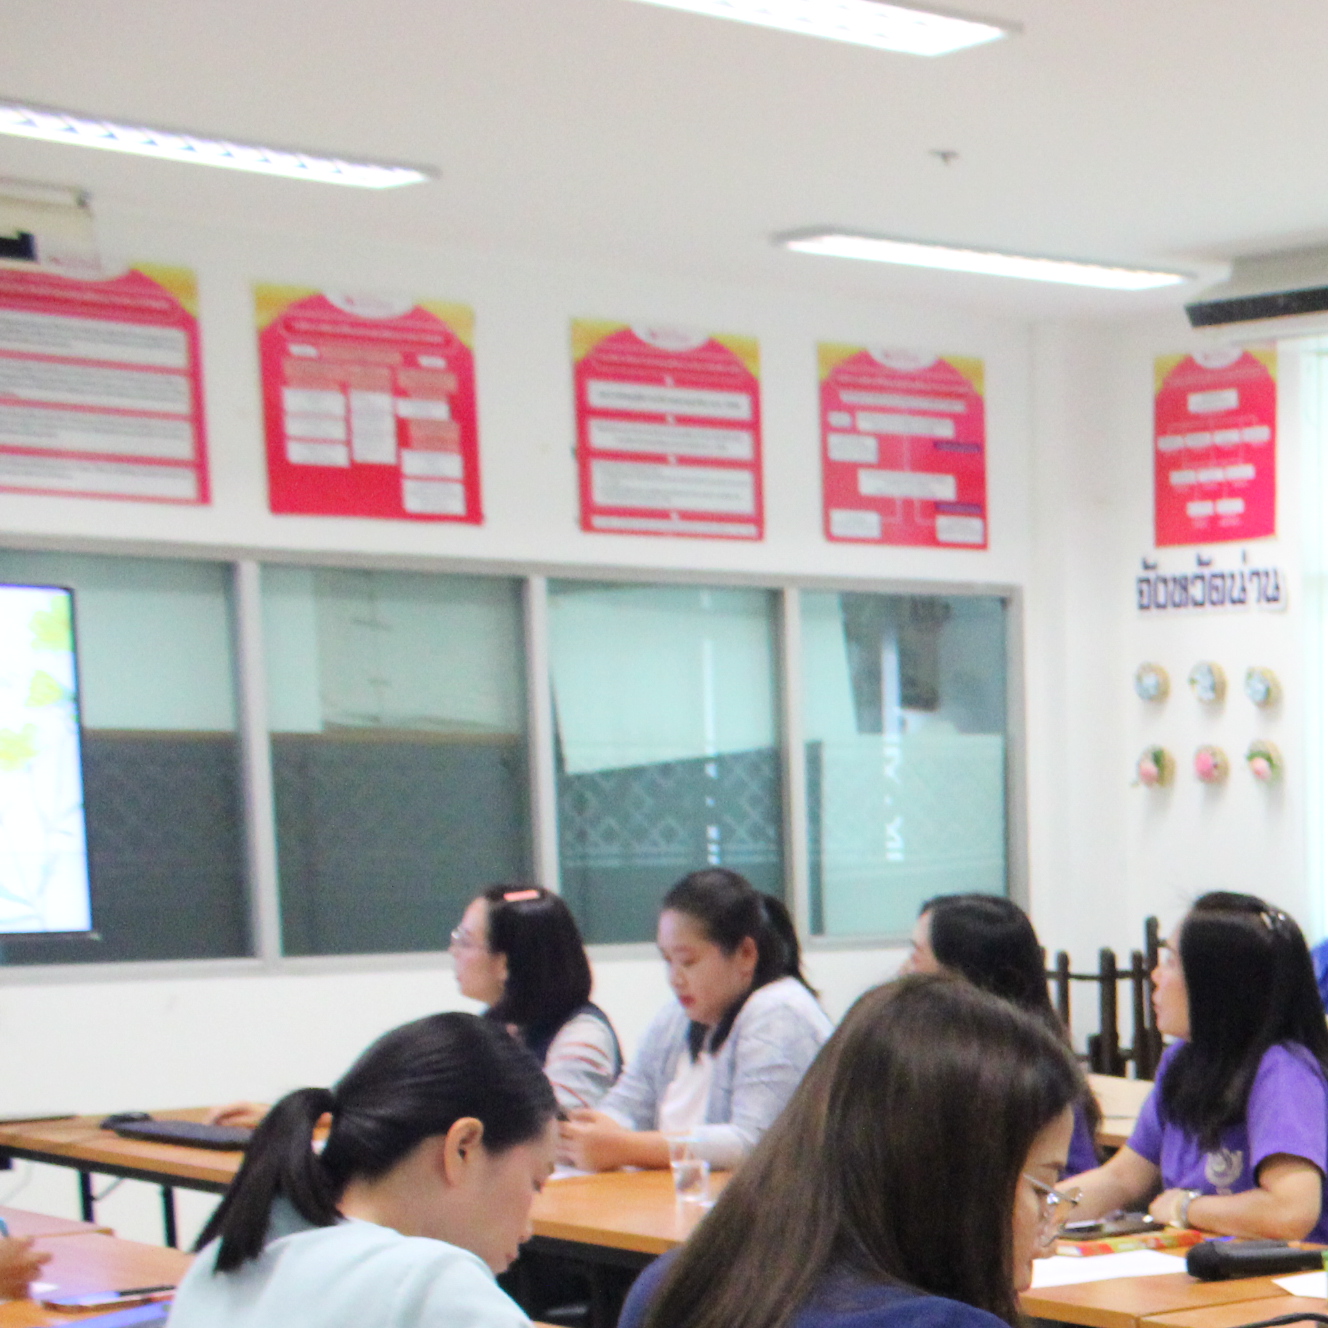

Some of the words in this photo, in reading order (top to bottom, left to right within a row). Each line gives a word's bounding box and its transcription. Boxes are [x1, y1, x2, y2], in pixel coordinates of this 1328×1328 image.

[1137, 549, 1280, 610] จังหวัดน่าน
